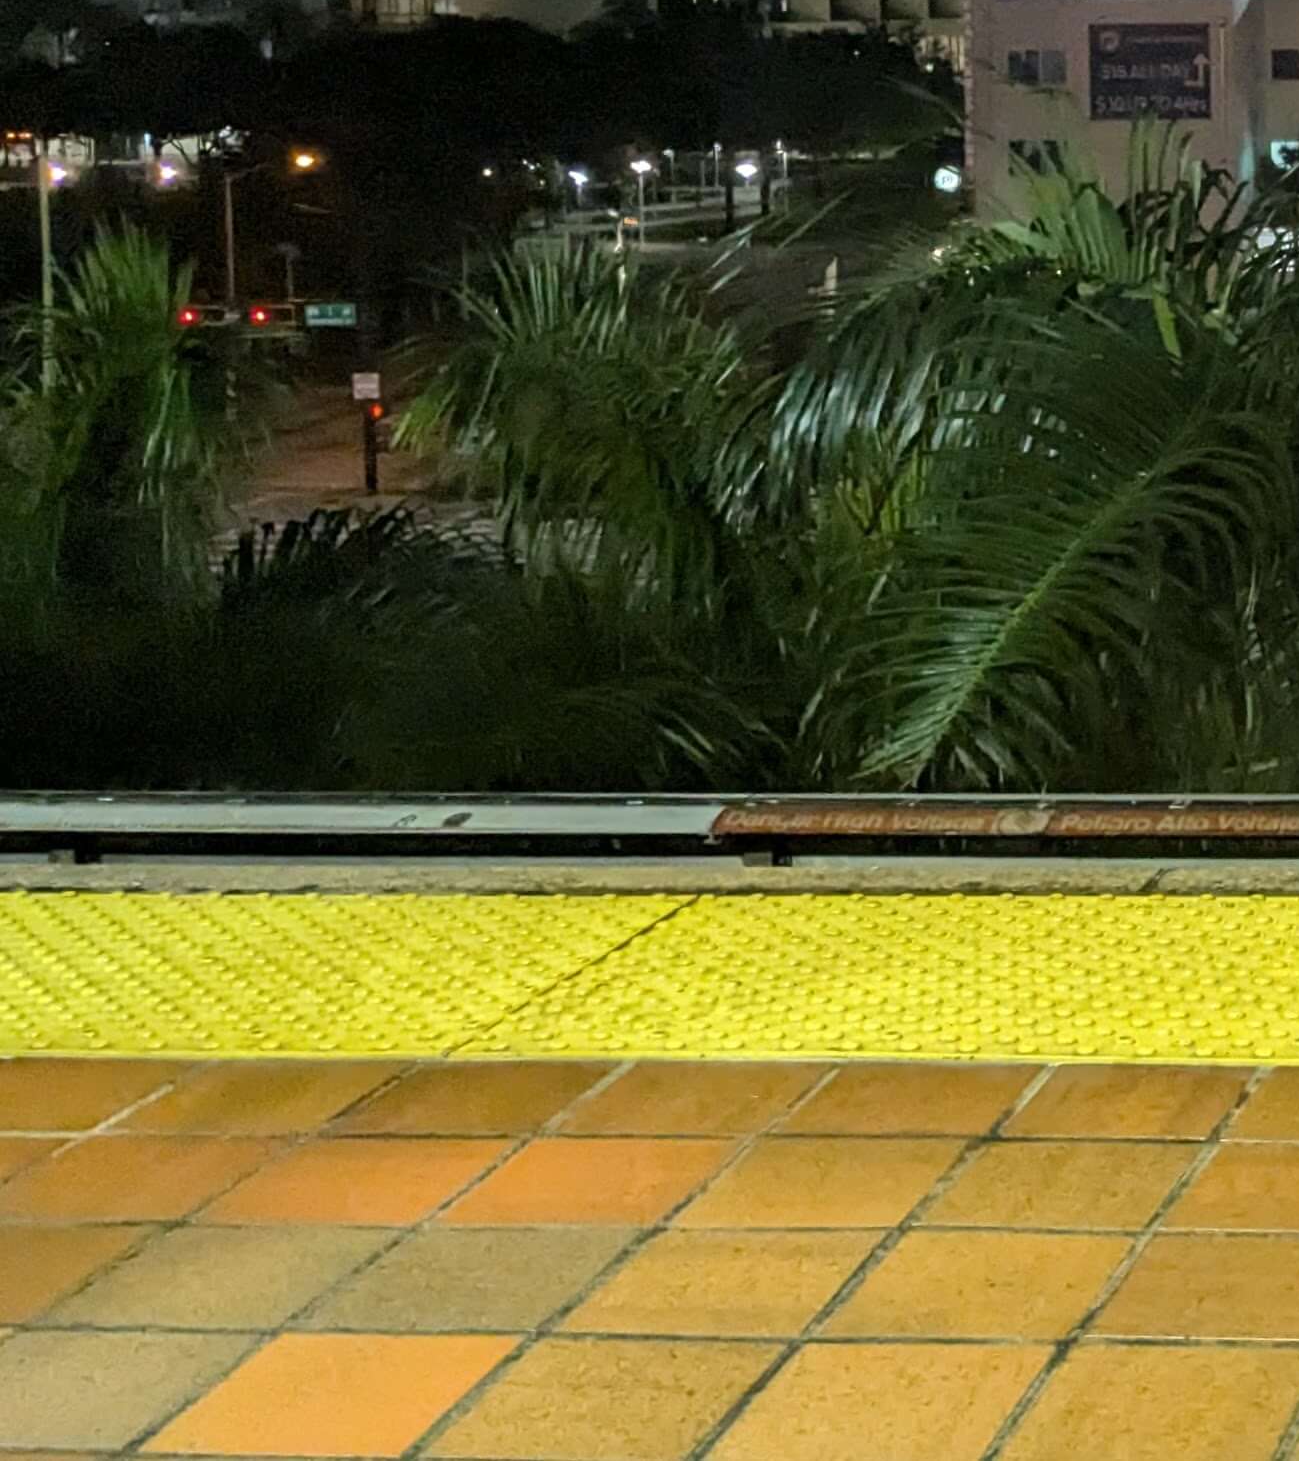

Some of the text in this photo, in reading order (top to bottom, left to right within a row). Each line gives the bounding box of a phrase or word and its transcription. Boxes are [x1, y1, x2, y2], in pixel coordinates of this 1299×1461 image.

[727, 810, 817, 830] Danger
[823, 810, 884, 830] High
[1060, 812, 1149, 834] Peligro
[1155, 812, 1209, 830] Alto
